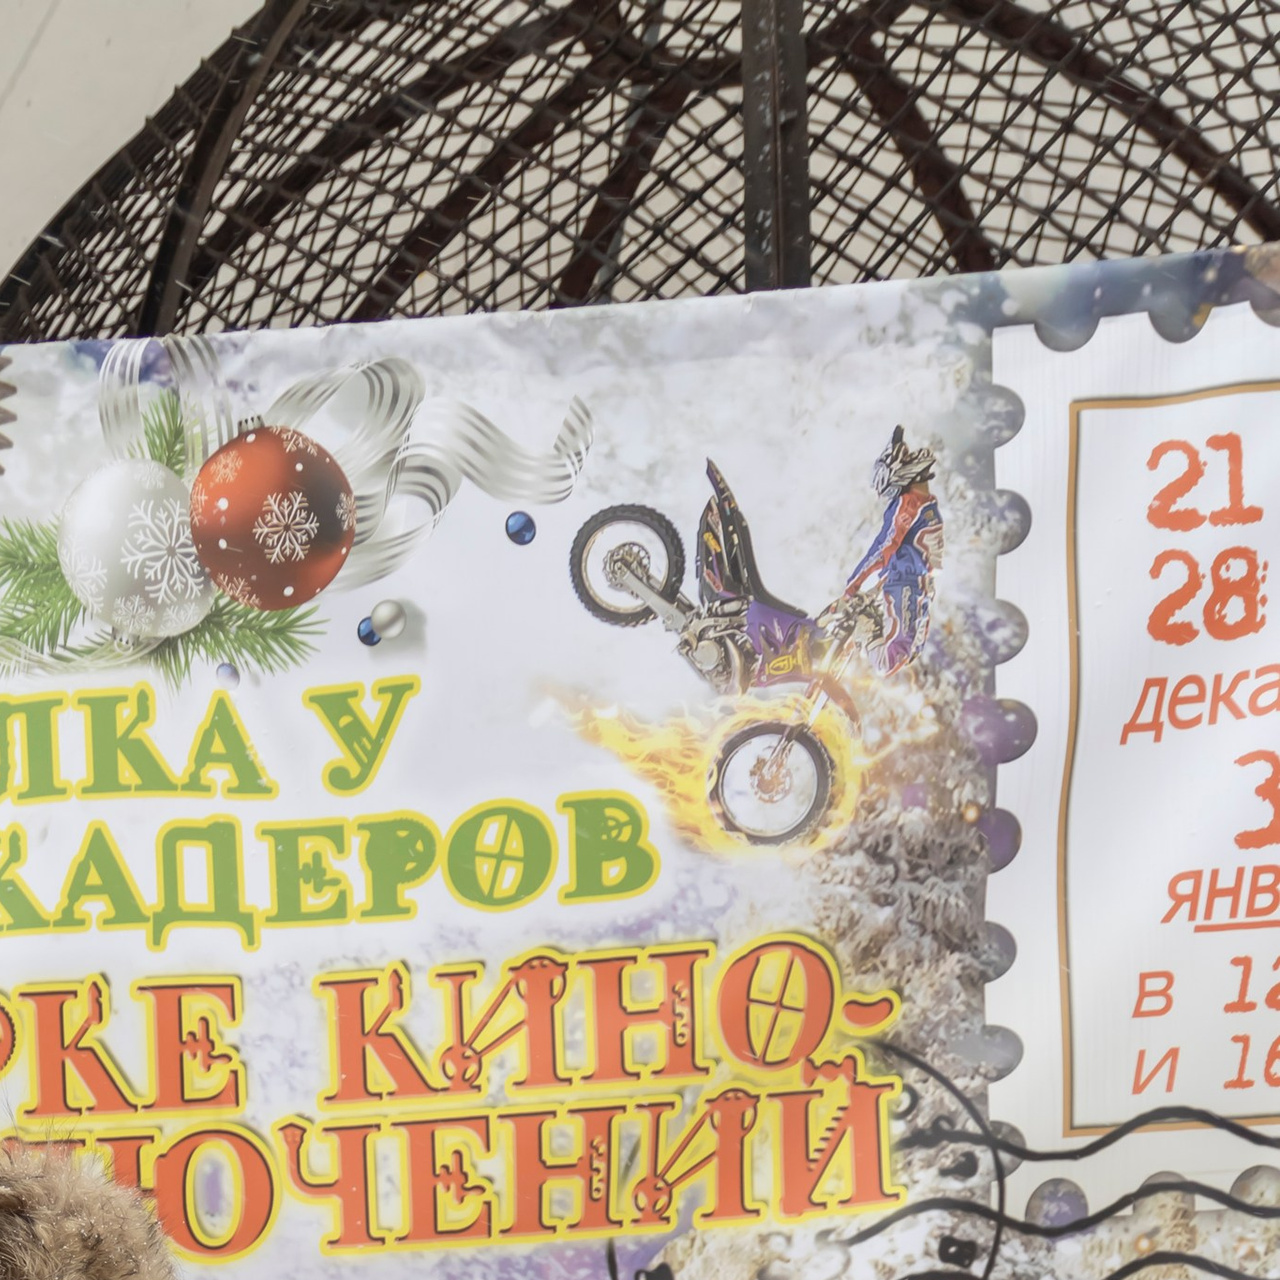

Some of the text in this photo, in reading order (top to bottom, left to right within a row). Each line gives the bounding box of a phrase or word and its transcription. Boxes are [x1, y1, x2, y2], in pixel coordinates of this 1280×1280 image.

[1147, 432, 1264, 532] 21
[1147, 545, 1269, 646] 28
[306, 680, 419, 790] У
[319, 941, 900, 1104] КИНО-
